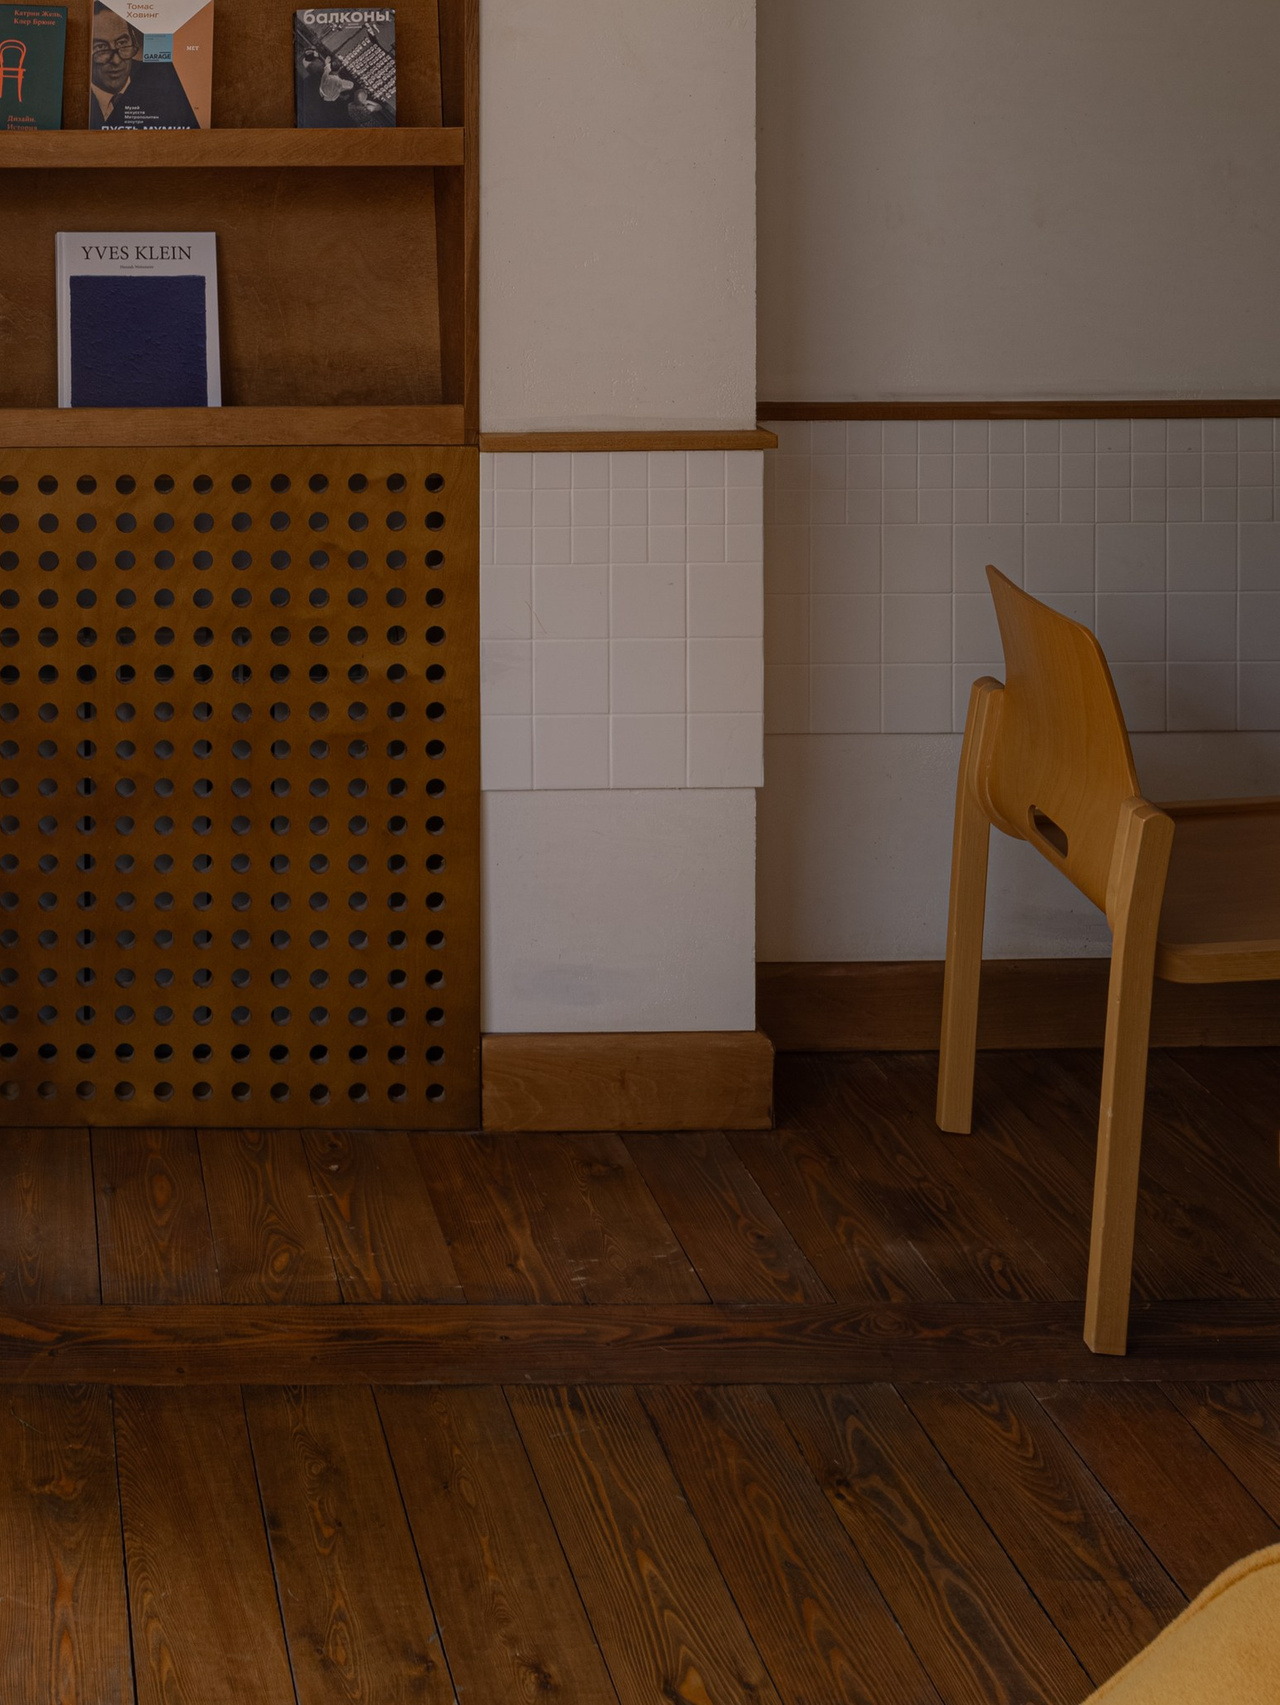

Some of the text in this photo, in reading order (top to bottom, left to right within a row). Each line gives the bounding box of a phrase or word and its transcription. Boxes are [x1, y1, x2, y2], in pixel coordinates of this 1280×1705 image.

[303, 9, 390, 24] балконы
[81, 245, 192, 261] YVES KLEIN
